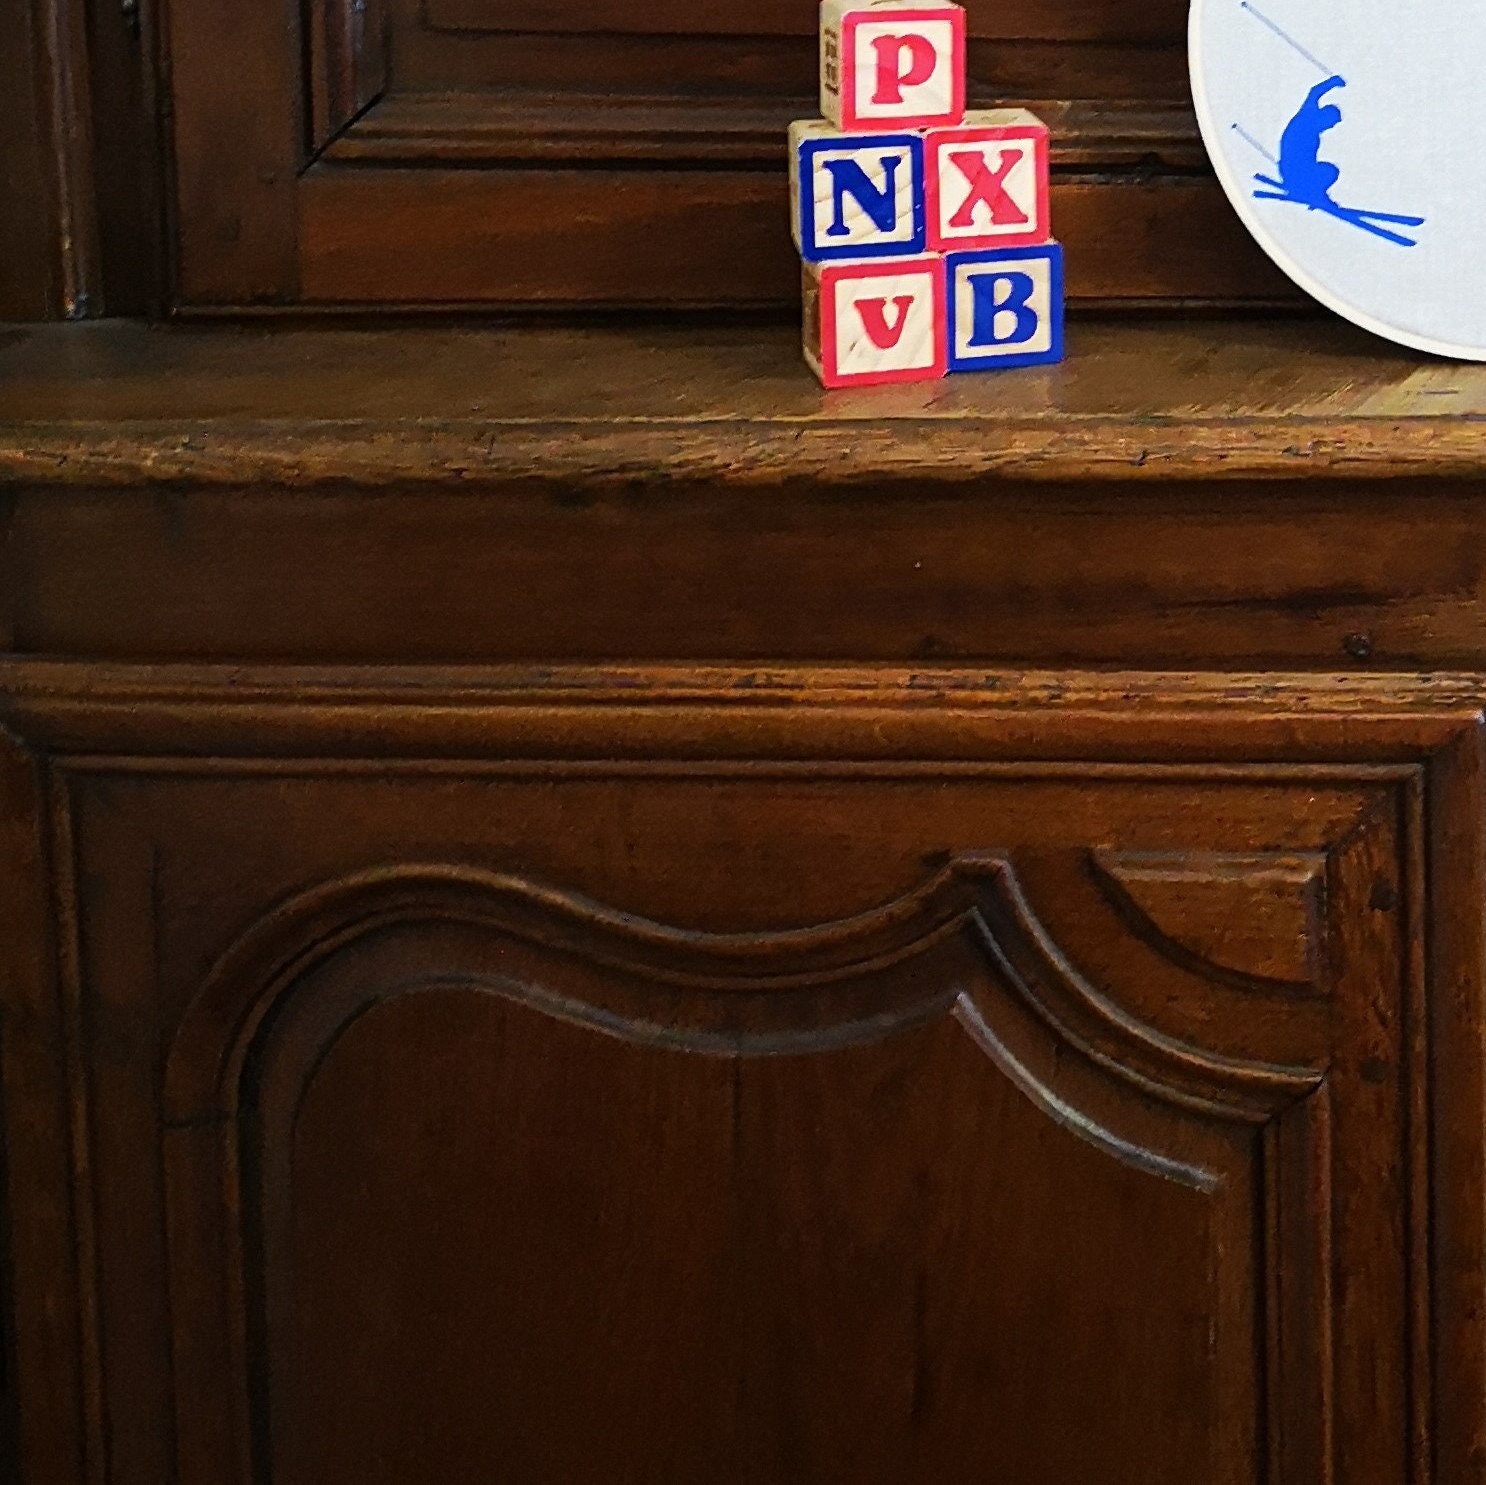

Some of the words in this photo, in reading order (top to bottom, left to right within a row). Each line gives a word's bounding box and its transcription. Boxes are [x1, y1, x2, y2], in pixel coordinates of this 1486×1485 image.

[822, 155, 903, 236] N
[947, 148, 1030, 228] X
[965, 271, 1039, 348] B
